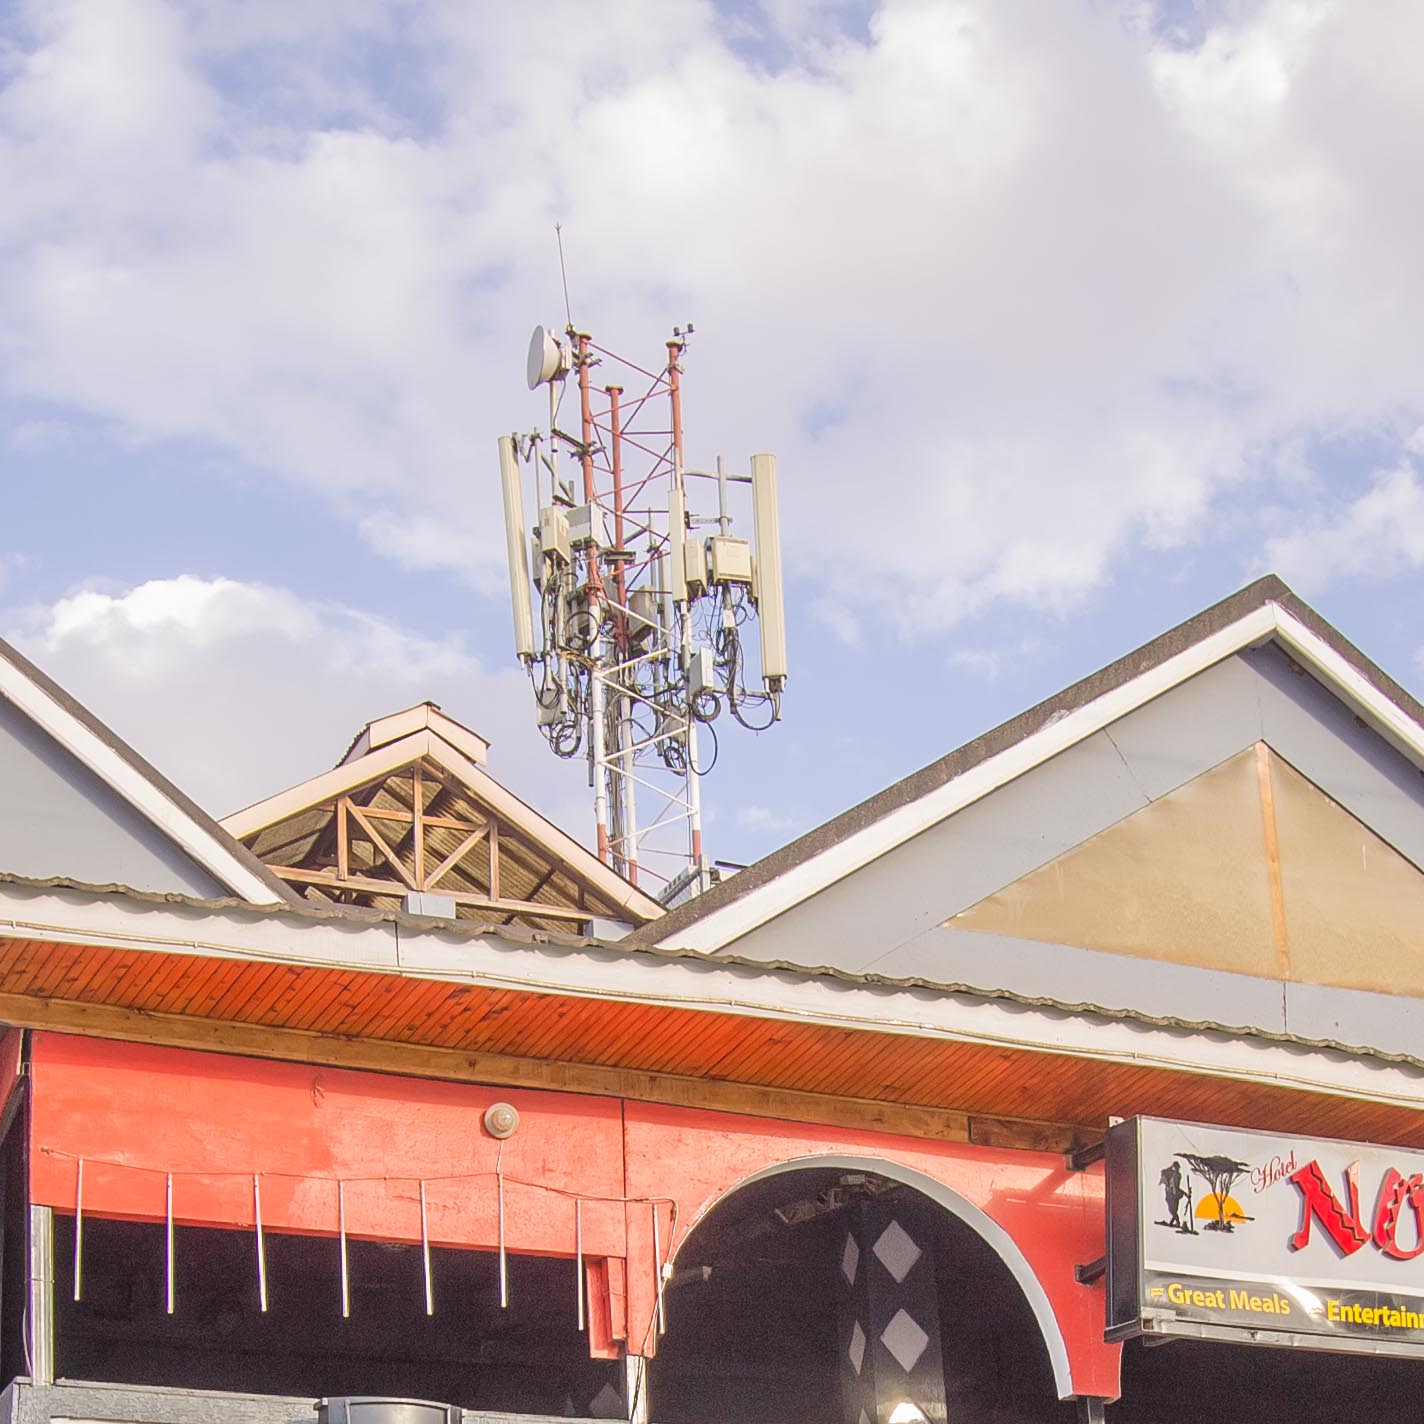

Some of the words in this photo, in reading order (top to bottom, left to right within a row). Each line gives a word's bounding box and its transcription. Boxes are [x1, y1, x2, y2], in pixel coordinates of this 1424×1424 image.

[1250, 1150, 1297, 1193] Hotel
[1167, 1283, 1224, 1311] Great
[1229, 1288, 1291, 1316] Meals
